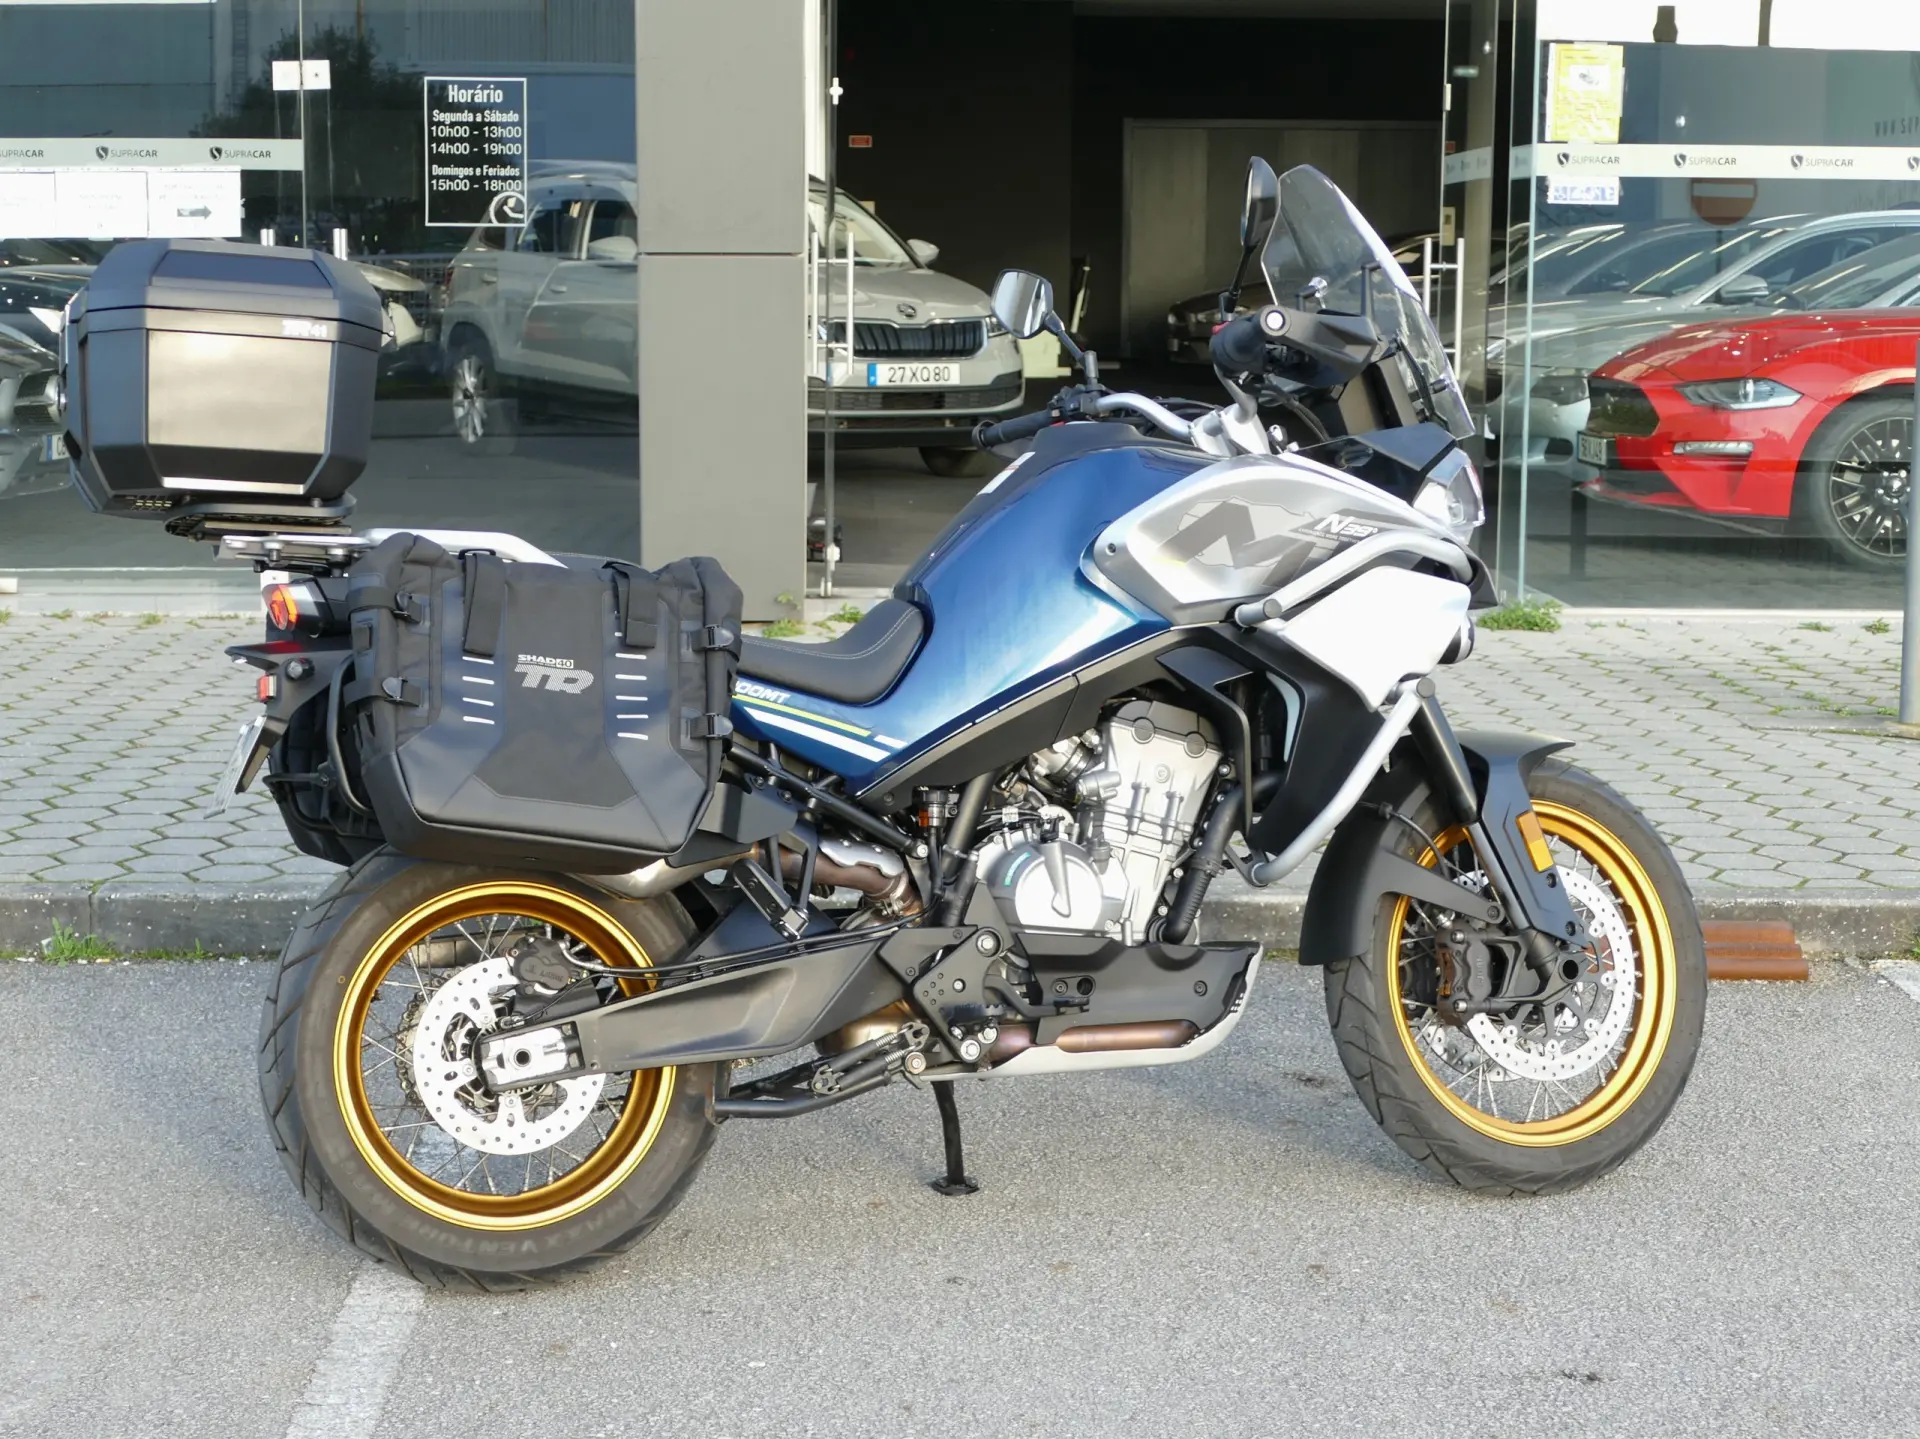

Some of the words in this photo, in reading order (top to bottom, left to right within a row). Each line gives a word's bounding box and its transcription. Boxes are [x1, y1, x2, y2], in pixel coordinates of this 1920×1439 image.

[448, 84, 503, 103] Horário
[432, 109, 473, 124] Segunda
[475, 113, 482, 122] a
[484, 109, 519, 122] Sábado
[430, 126, 470, 138] 10h00
[483, 126, 522, 138] 13h00
[0, 149, 45, 158] UPRACAR
[110, 149, 158, 158] SUPRACAR
[224, 149, 272, 159] SUPRACAR
[430, 143, 470, 155] 14h00
[483, 143, 522, 155] 19h00
[1571, 155, 1620, 165] SUPRACAR
[1688, 156, 1737, 166] SUPRACAR
[1805, 157, 1854, 167] SUPRACAR
[432, 164, 474, 178] Domingos
[475, 168, 481, 176] e
[483, 165, 520, 176] Feriados
[430, 179, 470, 191] 15h00
[483, 179, 522, 191] 18h00
[517, 654, 556, 665] SHAD
[556, 659, 573, 669] 40
[514, 663, 595, 695] TR
[735, 680, 791, 703] 00MT
